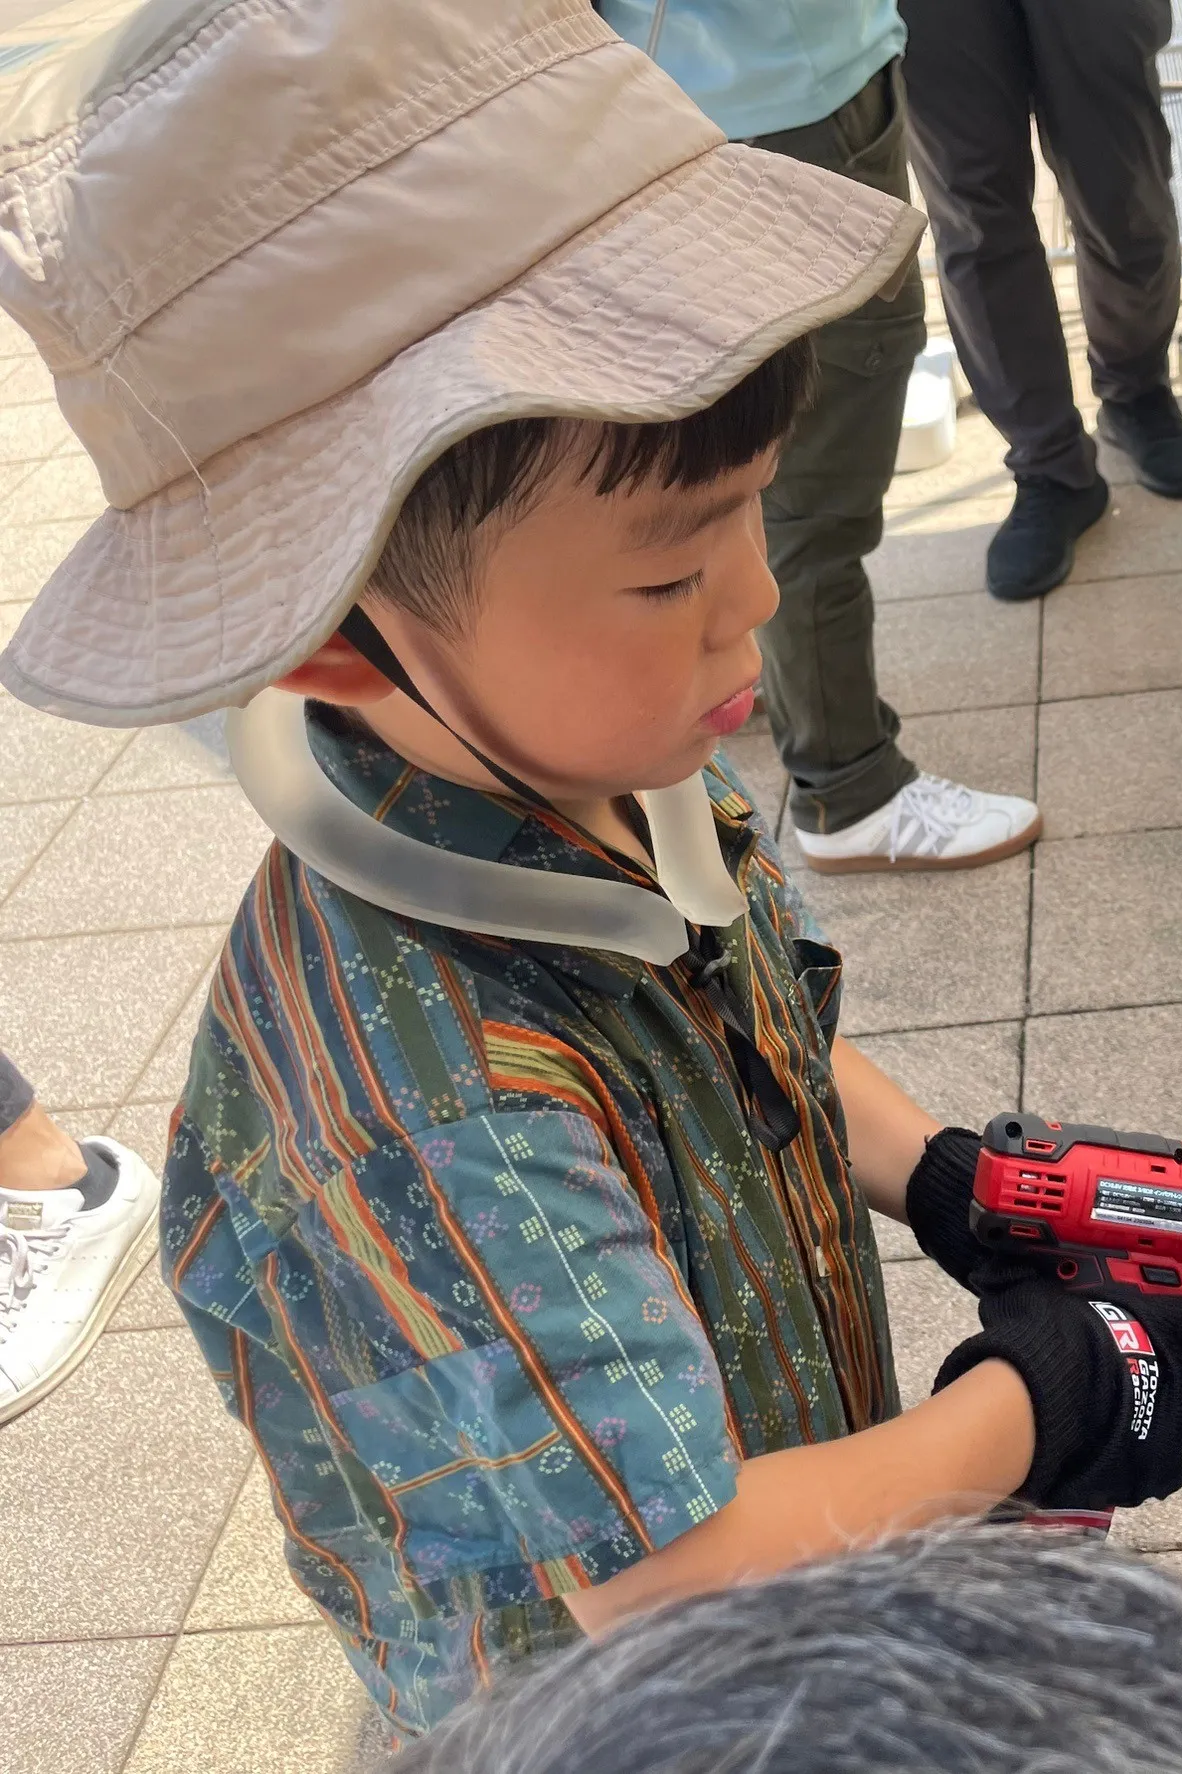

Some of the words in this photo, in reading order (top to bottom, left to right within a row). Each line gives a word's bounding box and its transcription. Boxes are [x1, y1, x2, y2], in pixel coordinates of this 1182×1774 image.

[1095, 1302, 1140, 1350] GR
[1133, 1358, 1150, 1432] GAZOO
[1136, 1360, 1160, 1440] TOYOTA
